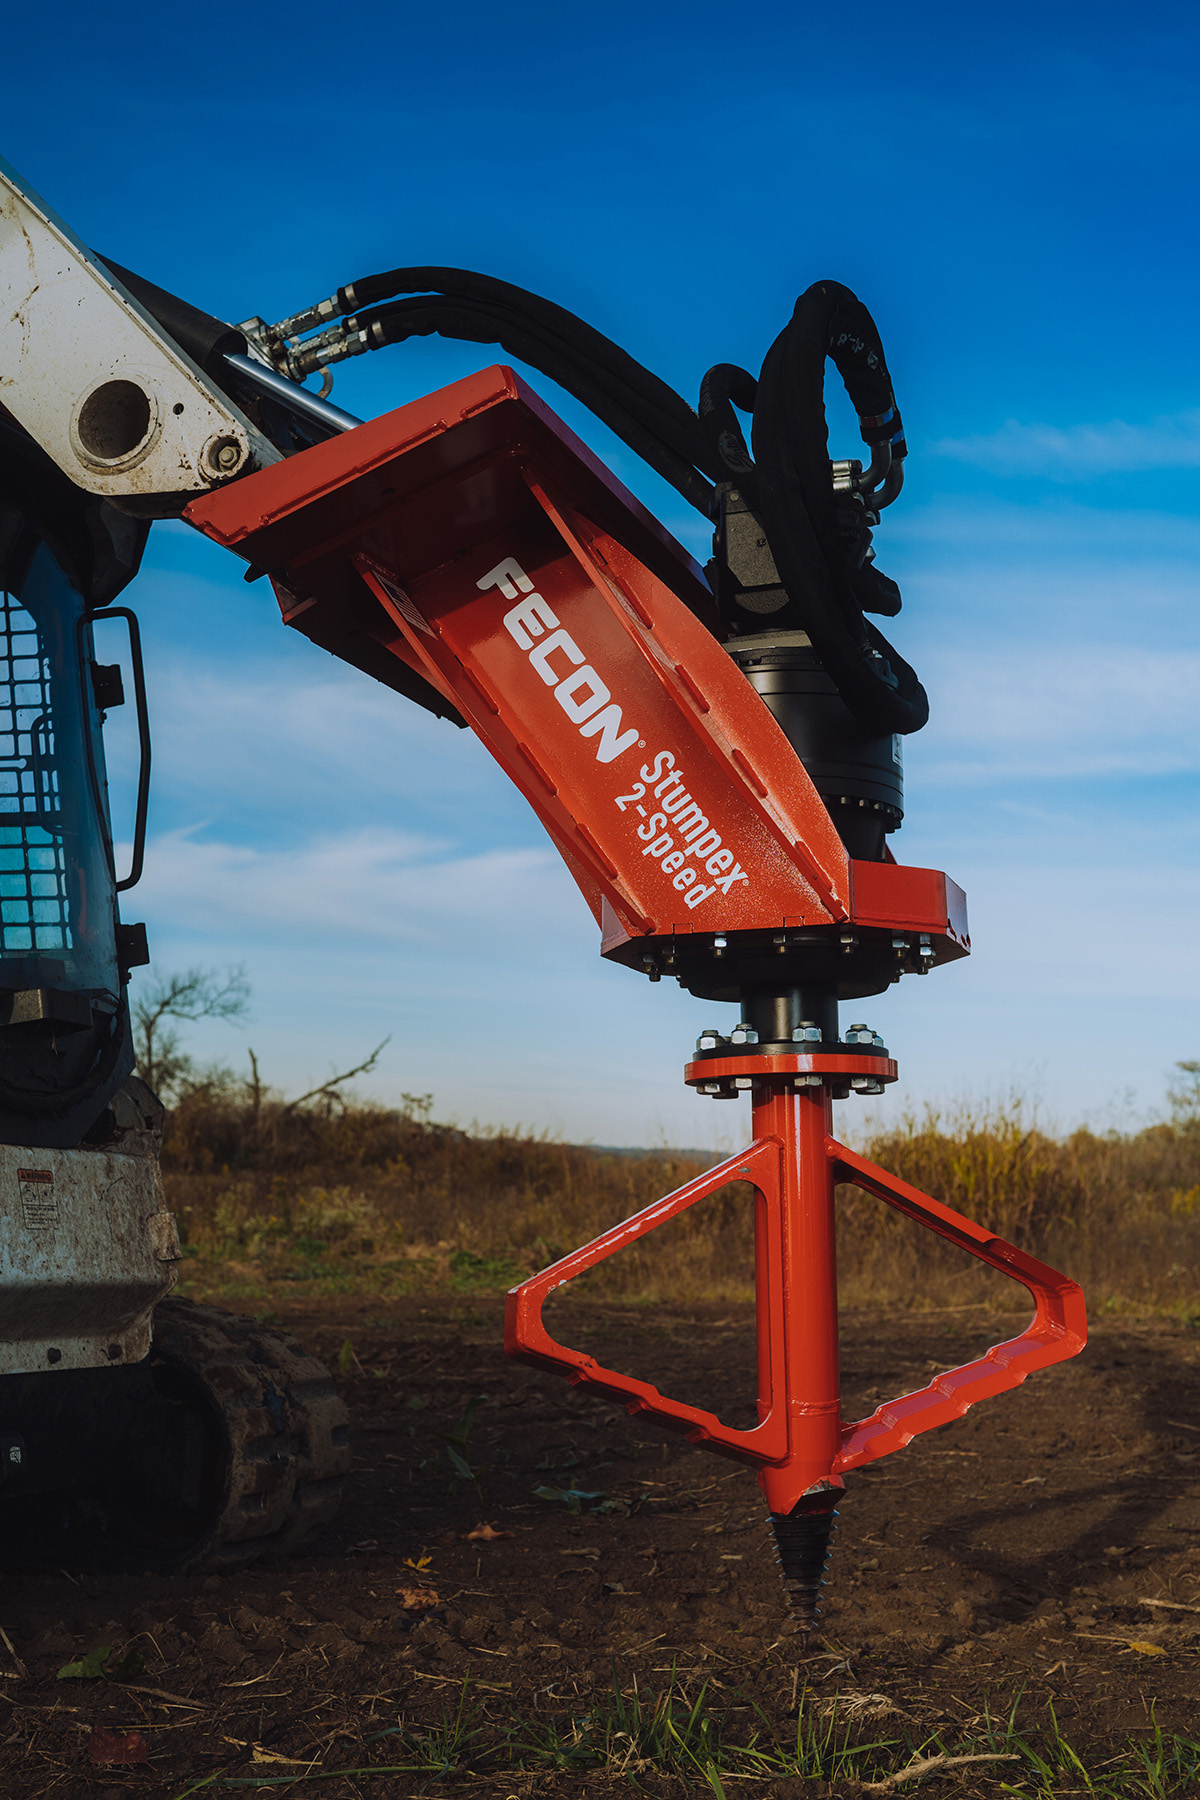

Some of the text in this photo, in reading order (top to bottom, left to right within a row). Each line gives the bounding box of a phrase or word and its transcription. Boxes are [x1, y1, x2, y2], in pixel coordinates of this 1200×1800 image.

[475, 556, 640, 763] FECON
[614, 782, 717, 910] 2-Speed
[639, 750, 749, 896] Stumpex
